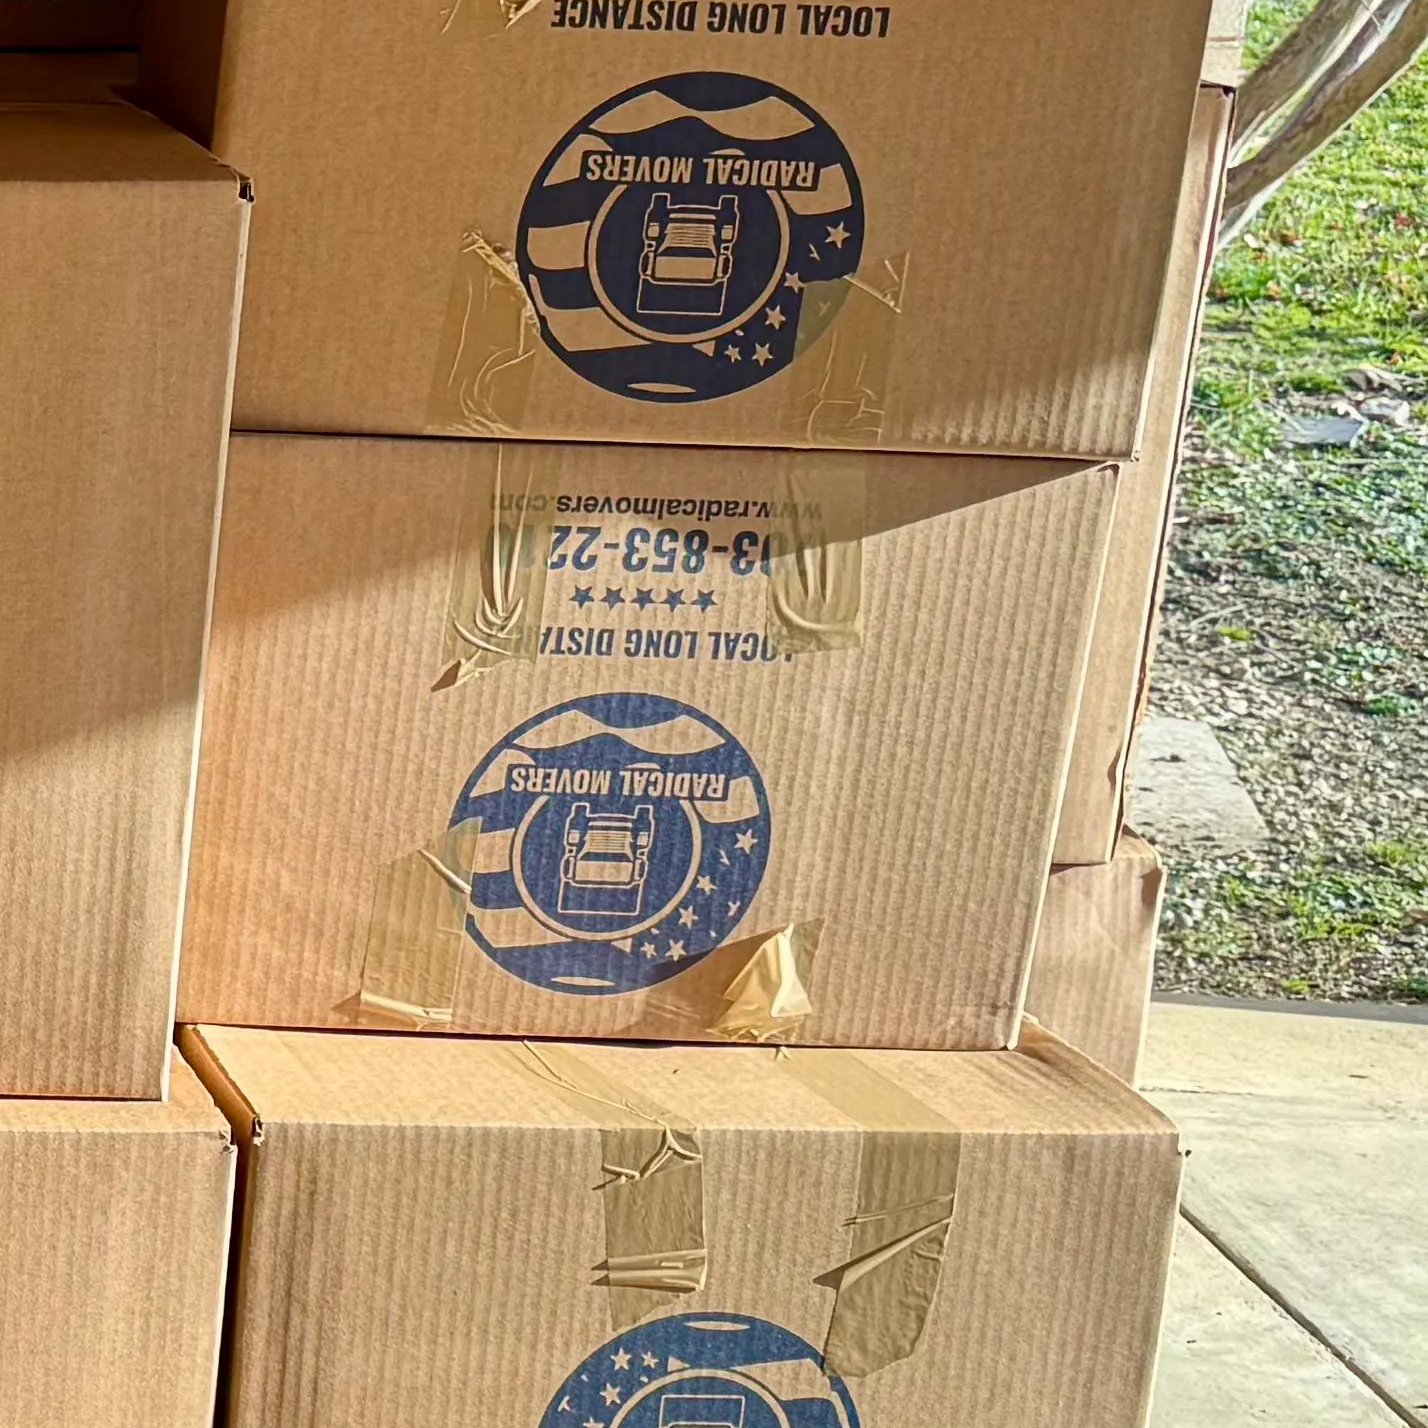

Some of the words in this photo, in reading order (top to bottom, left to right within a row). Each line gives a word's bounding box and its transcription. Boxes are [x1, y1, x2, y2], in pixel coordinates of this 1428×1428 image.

[707, 1, 785, 34] LONG
[796, 4, 890, 38] LOCAL
[587, 154, 692, 183] MOVERS
[703, 157, 814, 187] RADICAL
[625, 628, 697, 659] LONG
[511, 768, 611, 794] MOVERS
[620, 770, 725, 797] RADICAL
